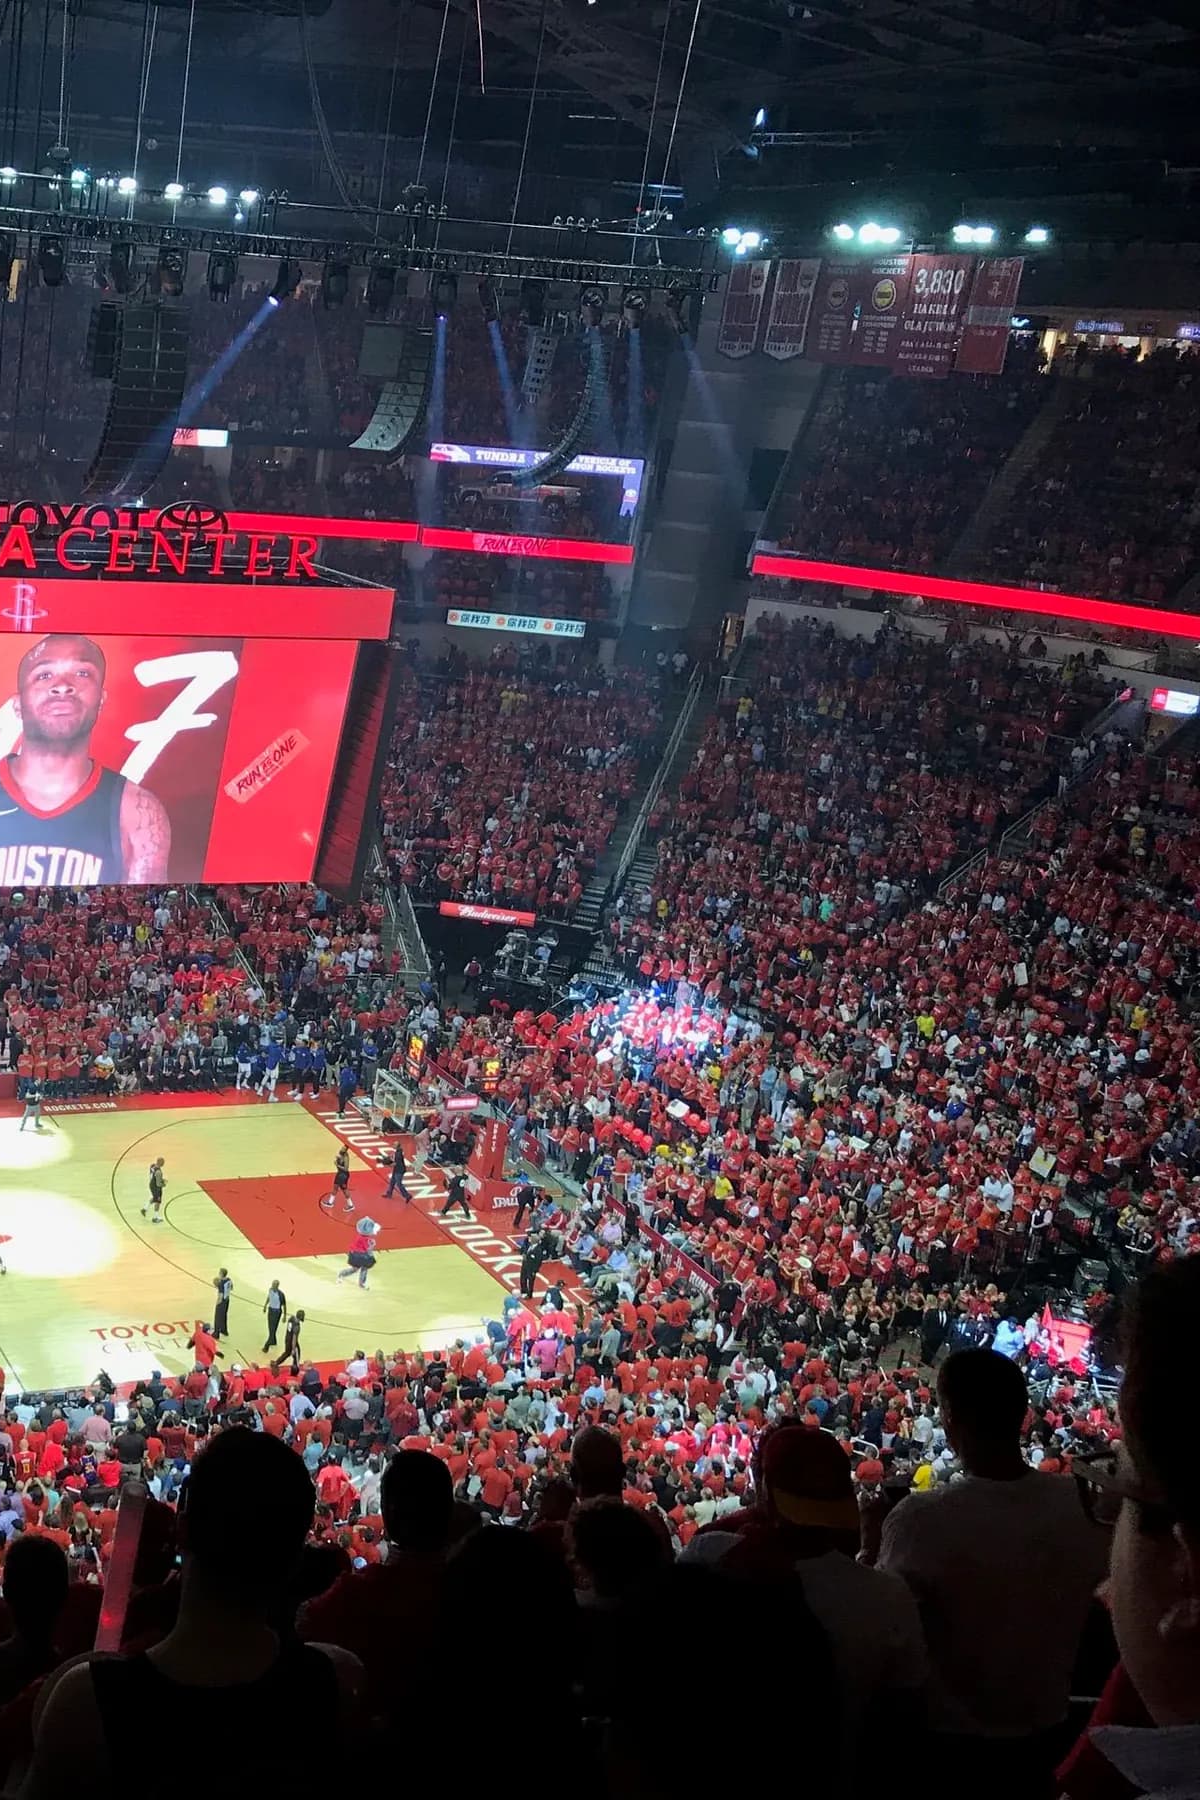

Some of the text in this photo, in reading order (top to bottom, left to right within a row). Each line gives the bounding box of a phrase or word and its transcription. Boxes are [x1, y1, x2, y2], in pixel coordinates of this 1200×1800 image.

[914, 268, 966, 298] 3,830
[475, 450, 526, 463] TUNDRA
[55, 526, 320, 578] CENTER
[124, 650, 239, 785] 7
[236, 765, 262, 795] RUN
[273, 735, 297, 763] ONE
[457, 904, 518, 923] Budweiser
[43, 1101, 118, 1112] ROCKETS.COM
